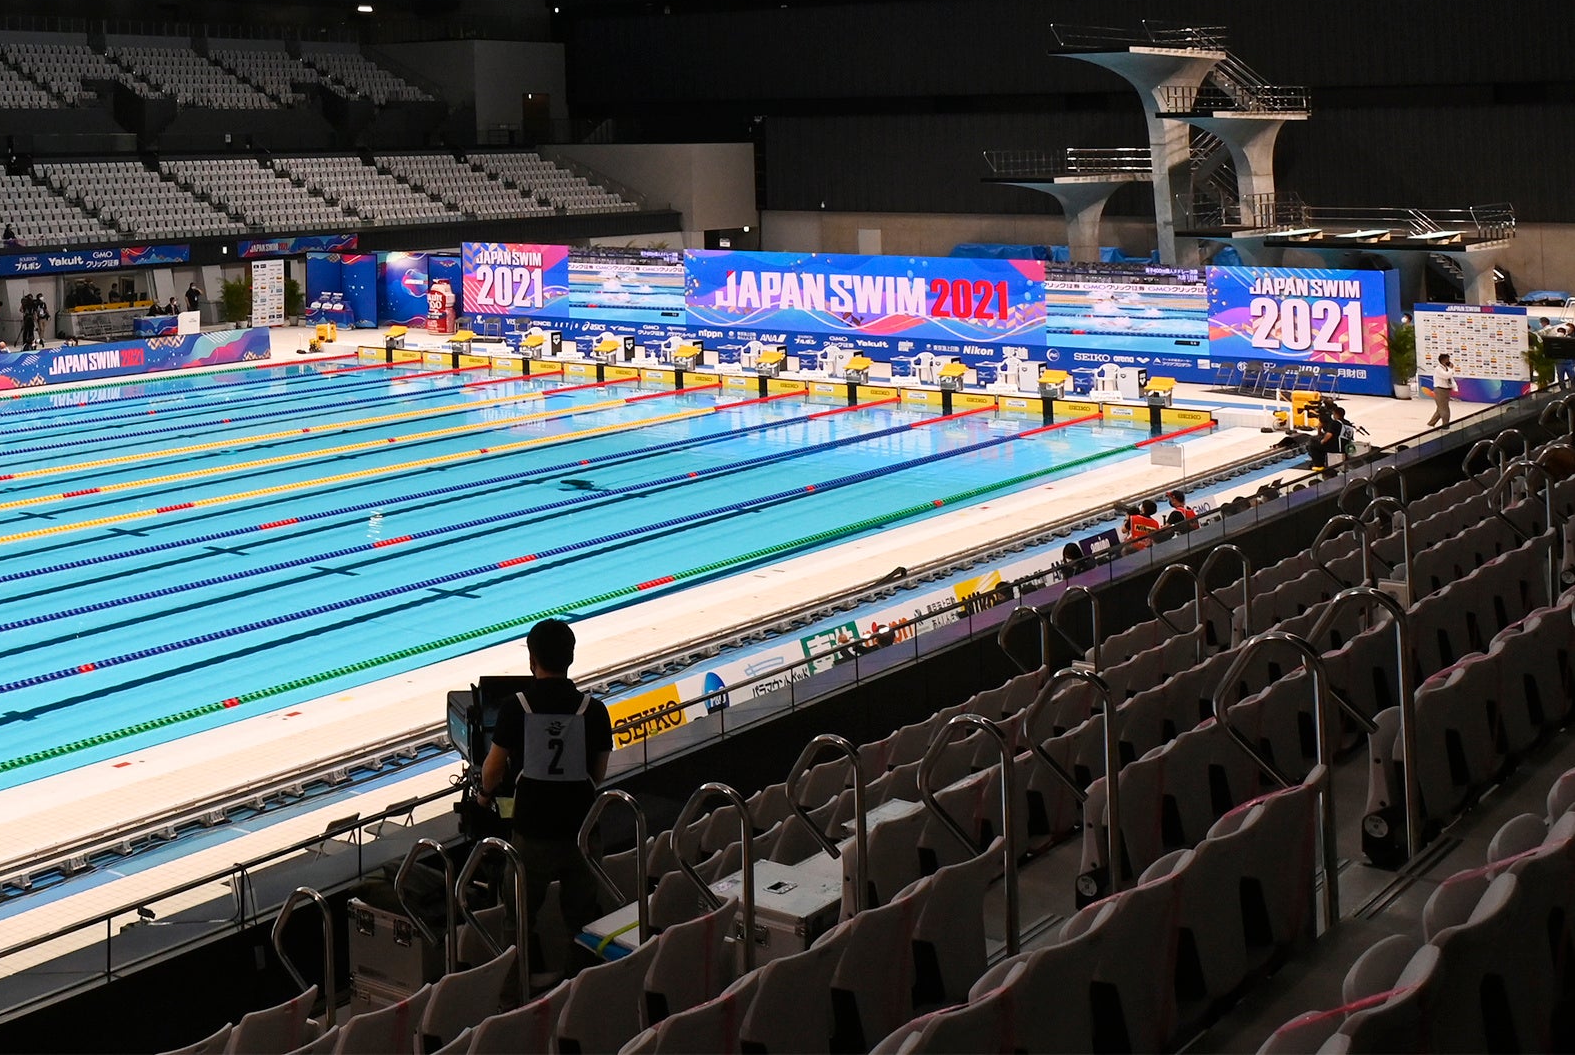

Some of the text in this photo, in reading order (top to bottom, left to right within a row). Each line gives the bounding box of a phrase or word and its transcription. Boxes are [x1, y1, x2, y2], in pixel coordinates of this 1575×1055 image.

[48, 255, 84, 267] Yakult
[476, 250, 543, 267] JAPAN SWIM
[476, 266, 544, 309] 2021
[714, 270, 1009, 321] JAPAN SWIM 2021
[1249, 277, 1362, 299] JAPAN SWIM
[1250, 297, 1363, 353] 2021
[856, 339, 889, 349] Yakult
[963, 345, 994, 356] Nikon
[49, 347, 144, 376] JAPAN SWIM 2021
[1073, 352, 1111, 363] SEIKO
[1113, 355, 1135, 364] arena
[614, 700, 682, 746] SEIKO
[548, 738, 565, 775] 2
